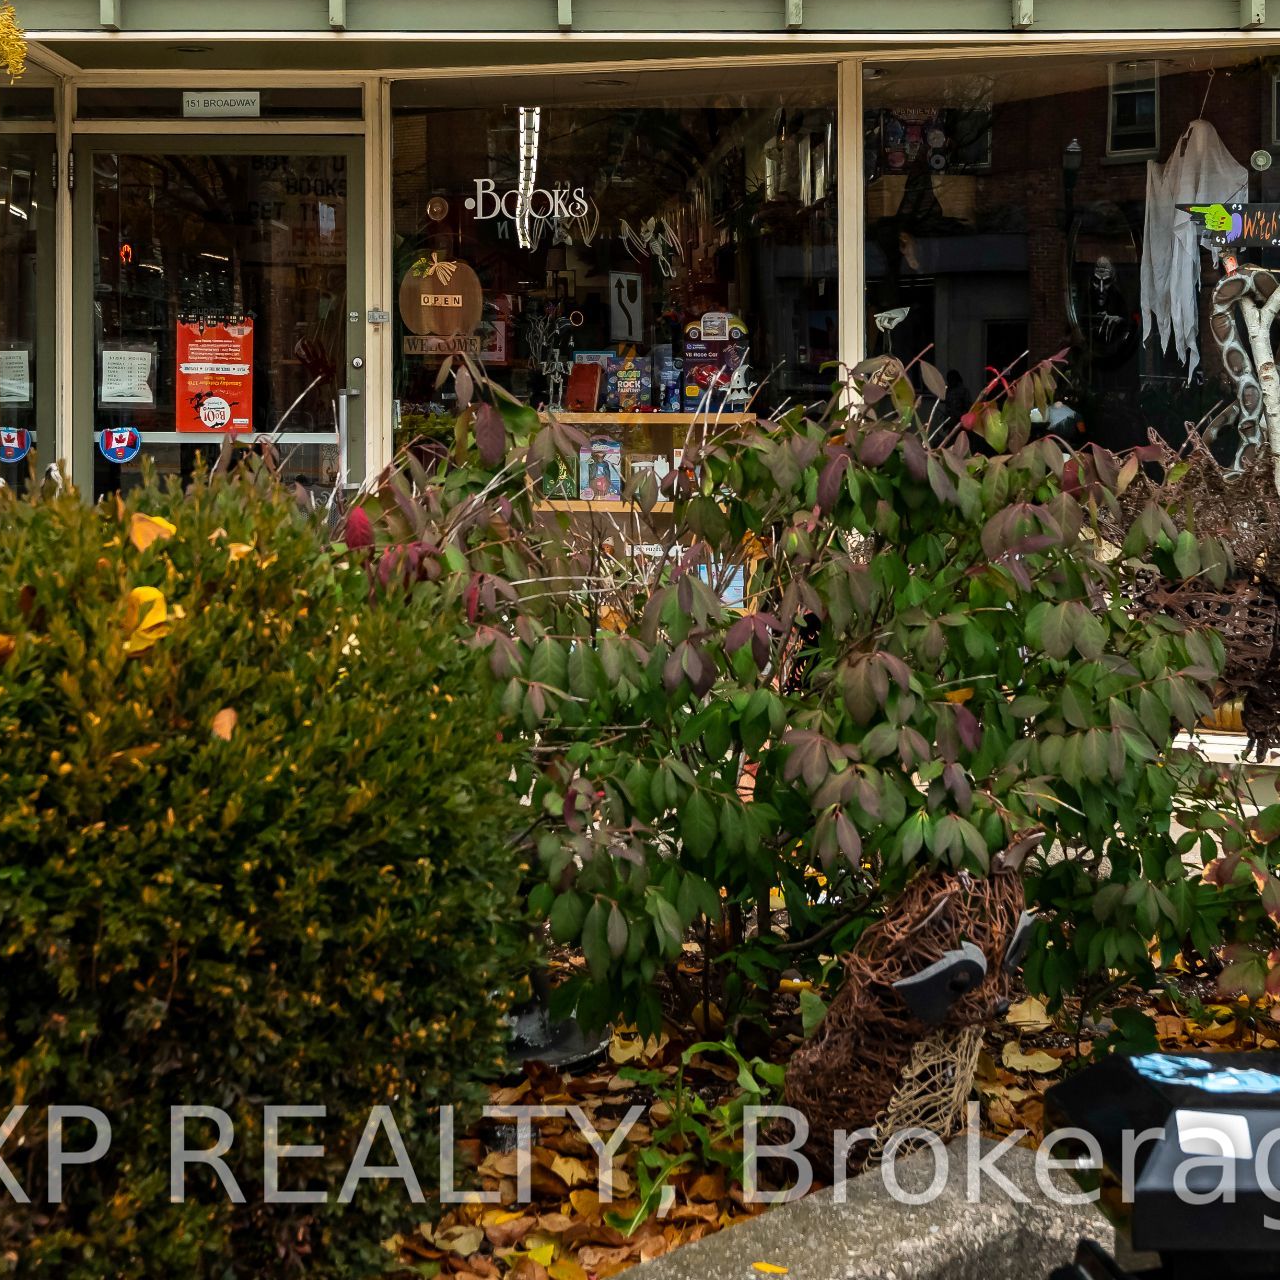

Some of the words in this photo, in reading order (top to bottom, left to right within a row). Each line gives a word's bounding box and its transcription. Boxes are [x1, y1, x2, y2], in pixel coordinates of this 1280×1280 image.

[186, 100, 200, 108] 151
[203, 98, 257, 108] BROADWAY
[423, 296, 461, 305] OPEN
[406, 338, 479, 352] WELCOME
[617, 380, 641, 388] ROCK
